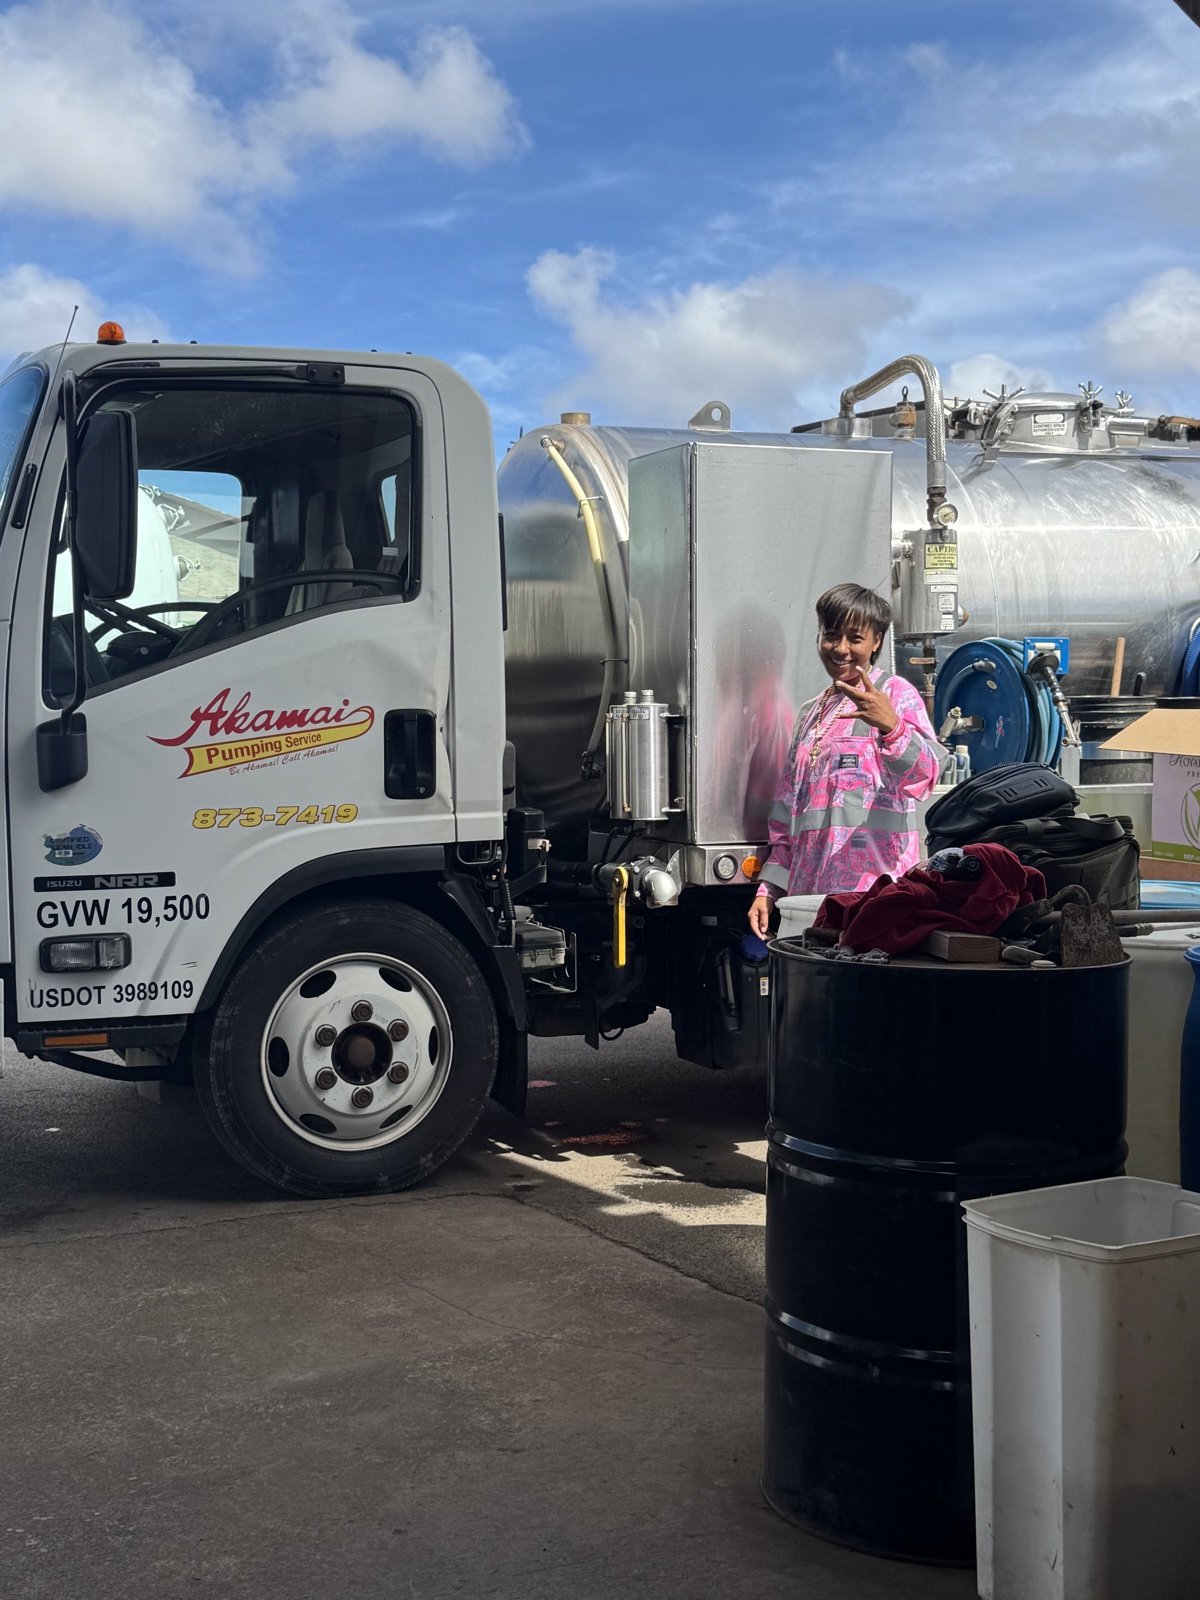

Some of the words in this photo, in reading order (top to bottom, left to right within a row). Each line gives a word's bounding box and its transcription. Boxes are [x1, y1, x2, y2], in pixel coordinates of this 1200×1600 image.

[147, 687, 358, 746] Akamai
[206, 739, 282, 765] Pumping
[285, 732, 322, 748] Service
[229, 766, 240, 776] Be
[242, 757, 280, 773] Akamai!
[281, 753, 301, 765] Call
[302, 743, 340, 760] Akamai!
[192, 803, 359, 829] 873-7419
[46, 879, 83, 888] ISUZU
[94, 874, 159, 889] NRR
[36, 899, 111, 928] GVW
[121, 893, 210, 928] 19,500
[30, 985, 106, 1009] USDOT
[113, 980, 194, 1004] 3989109
